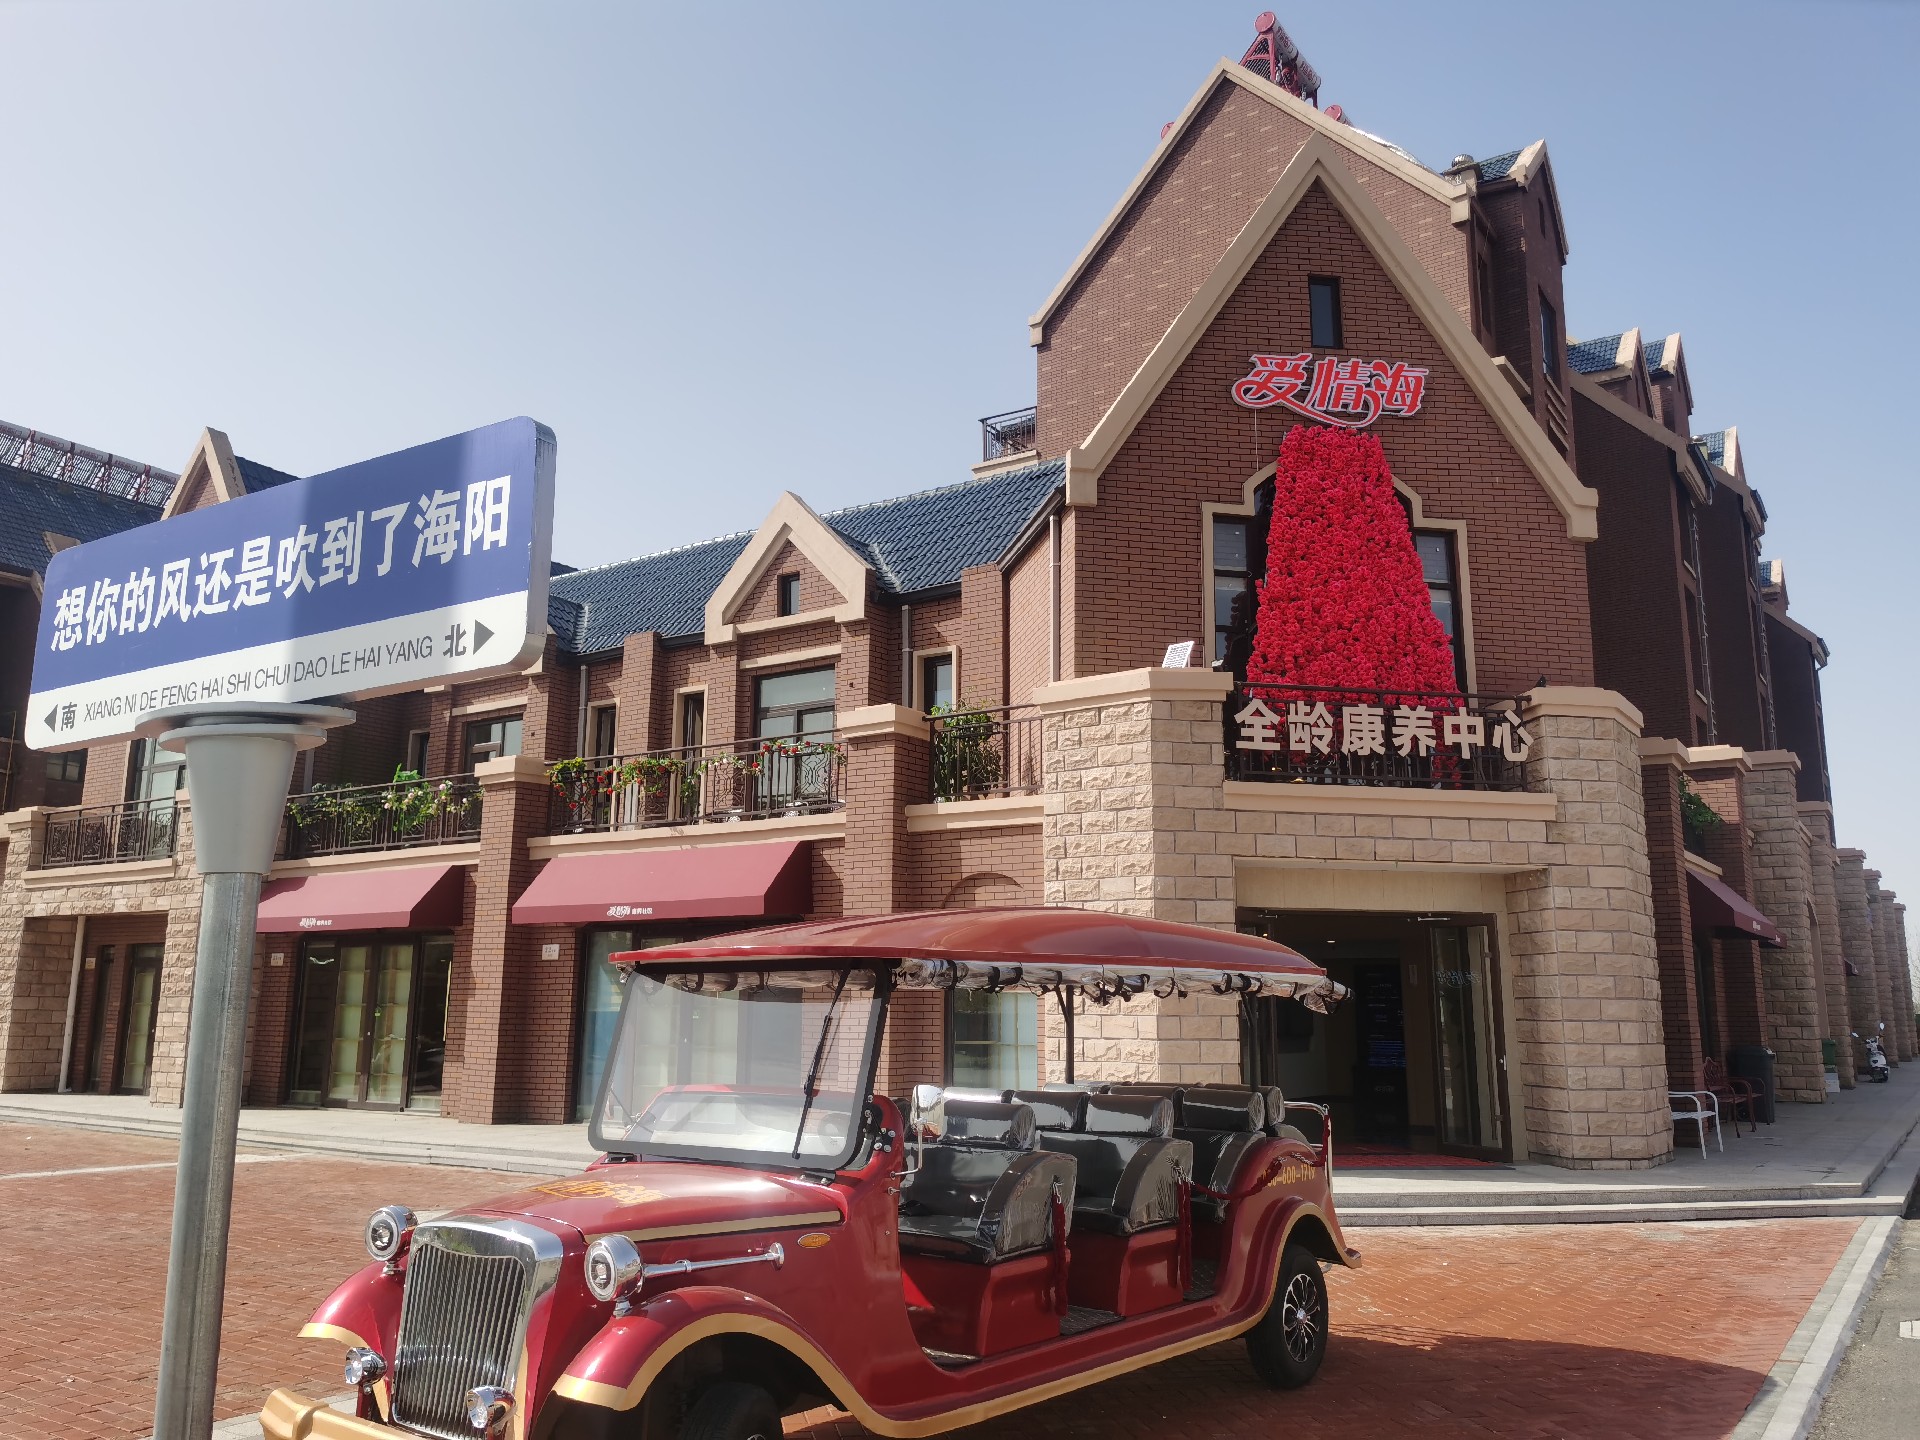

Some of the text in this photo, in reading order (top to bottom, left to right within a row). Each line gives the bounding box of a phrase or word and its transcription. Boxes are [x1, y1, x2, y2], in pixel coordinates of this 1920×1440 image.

[1231, 353, 1430, 428] 爱情海
[50, 474, 512, 652] 想你的风还是吹到了海阳
[60, 623, 467, 731] 南 XIANG NI DE FENG HAI SHI CHUI DAO LE HAI YANG 北
[1233, 699, 1535, 763] 全龄康养中心
